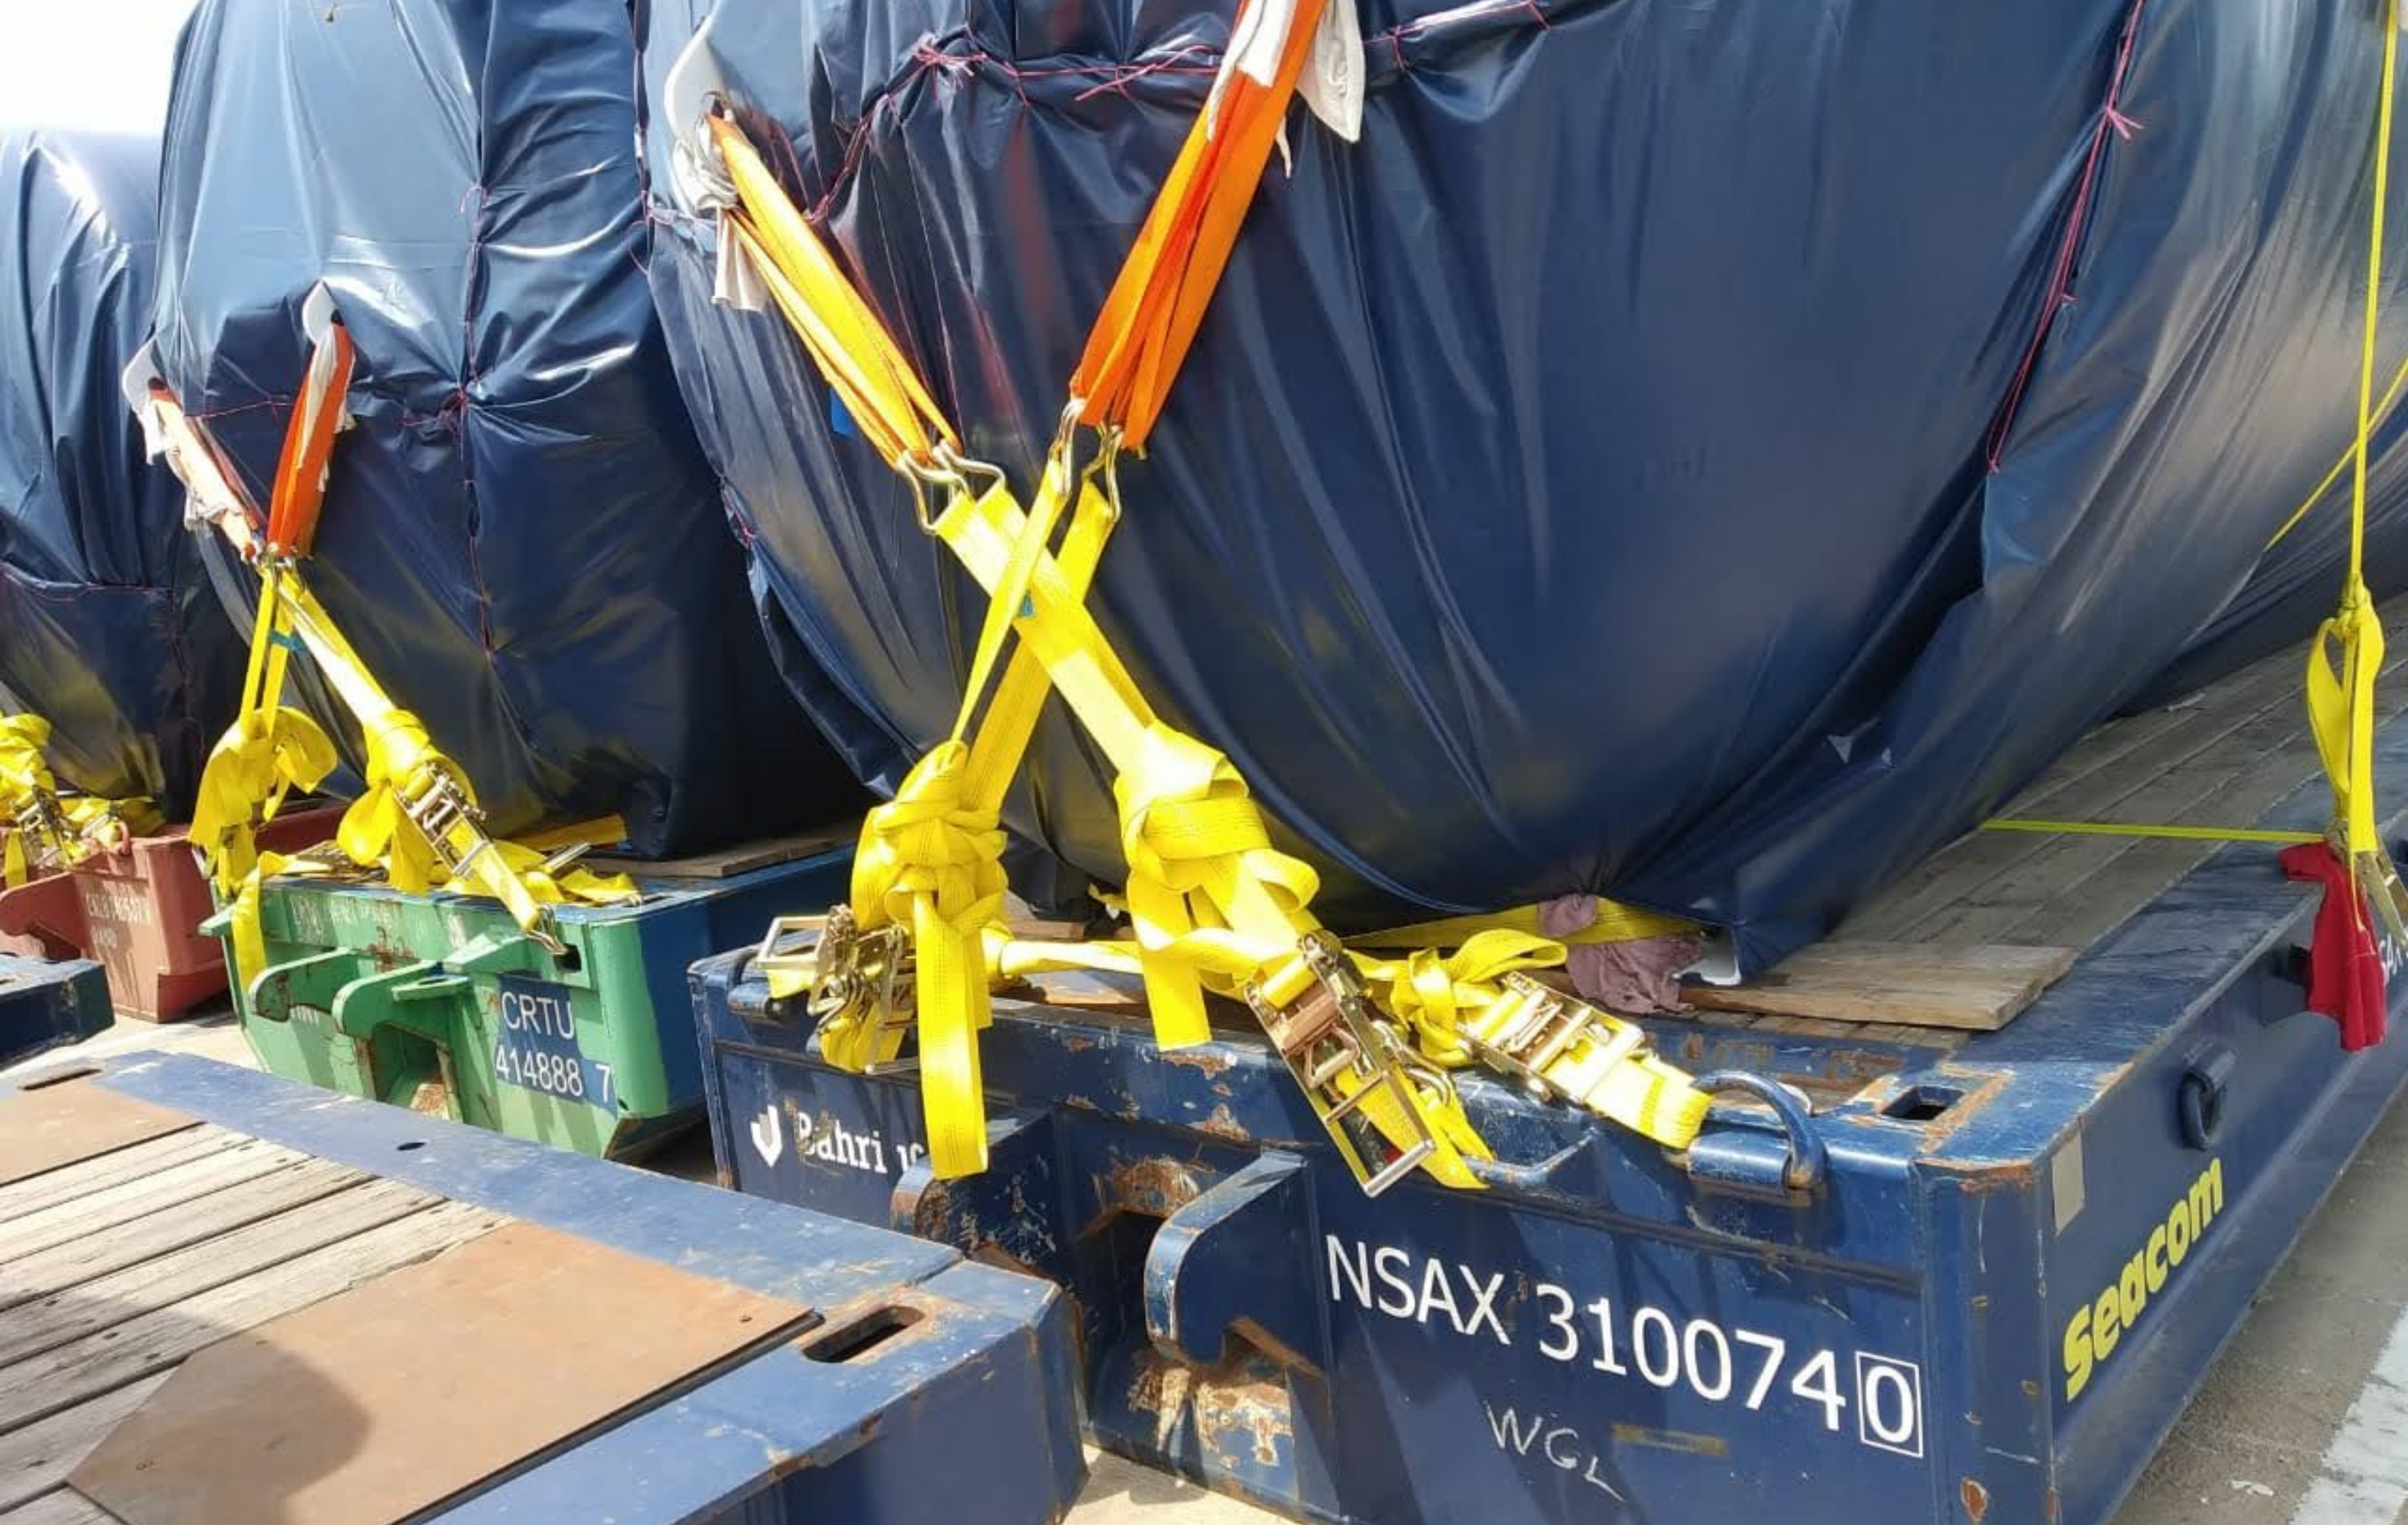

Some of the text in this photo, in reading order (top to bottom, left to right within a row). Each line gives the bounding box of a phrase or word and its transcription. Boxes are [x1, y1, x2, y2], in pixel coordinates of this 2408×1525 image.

[502, 991, 575, 1039] CRTU
[496, 1044, 611, 1104] 414888 7
[1326, 1234, 1512, 1346] NSAX
